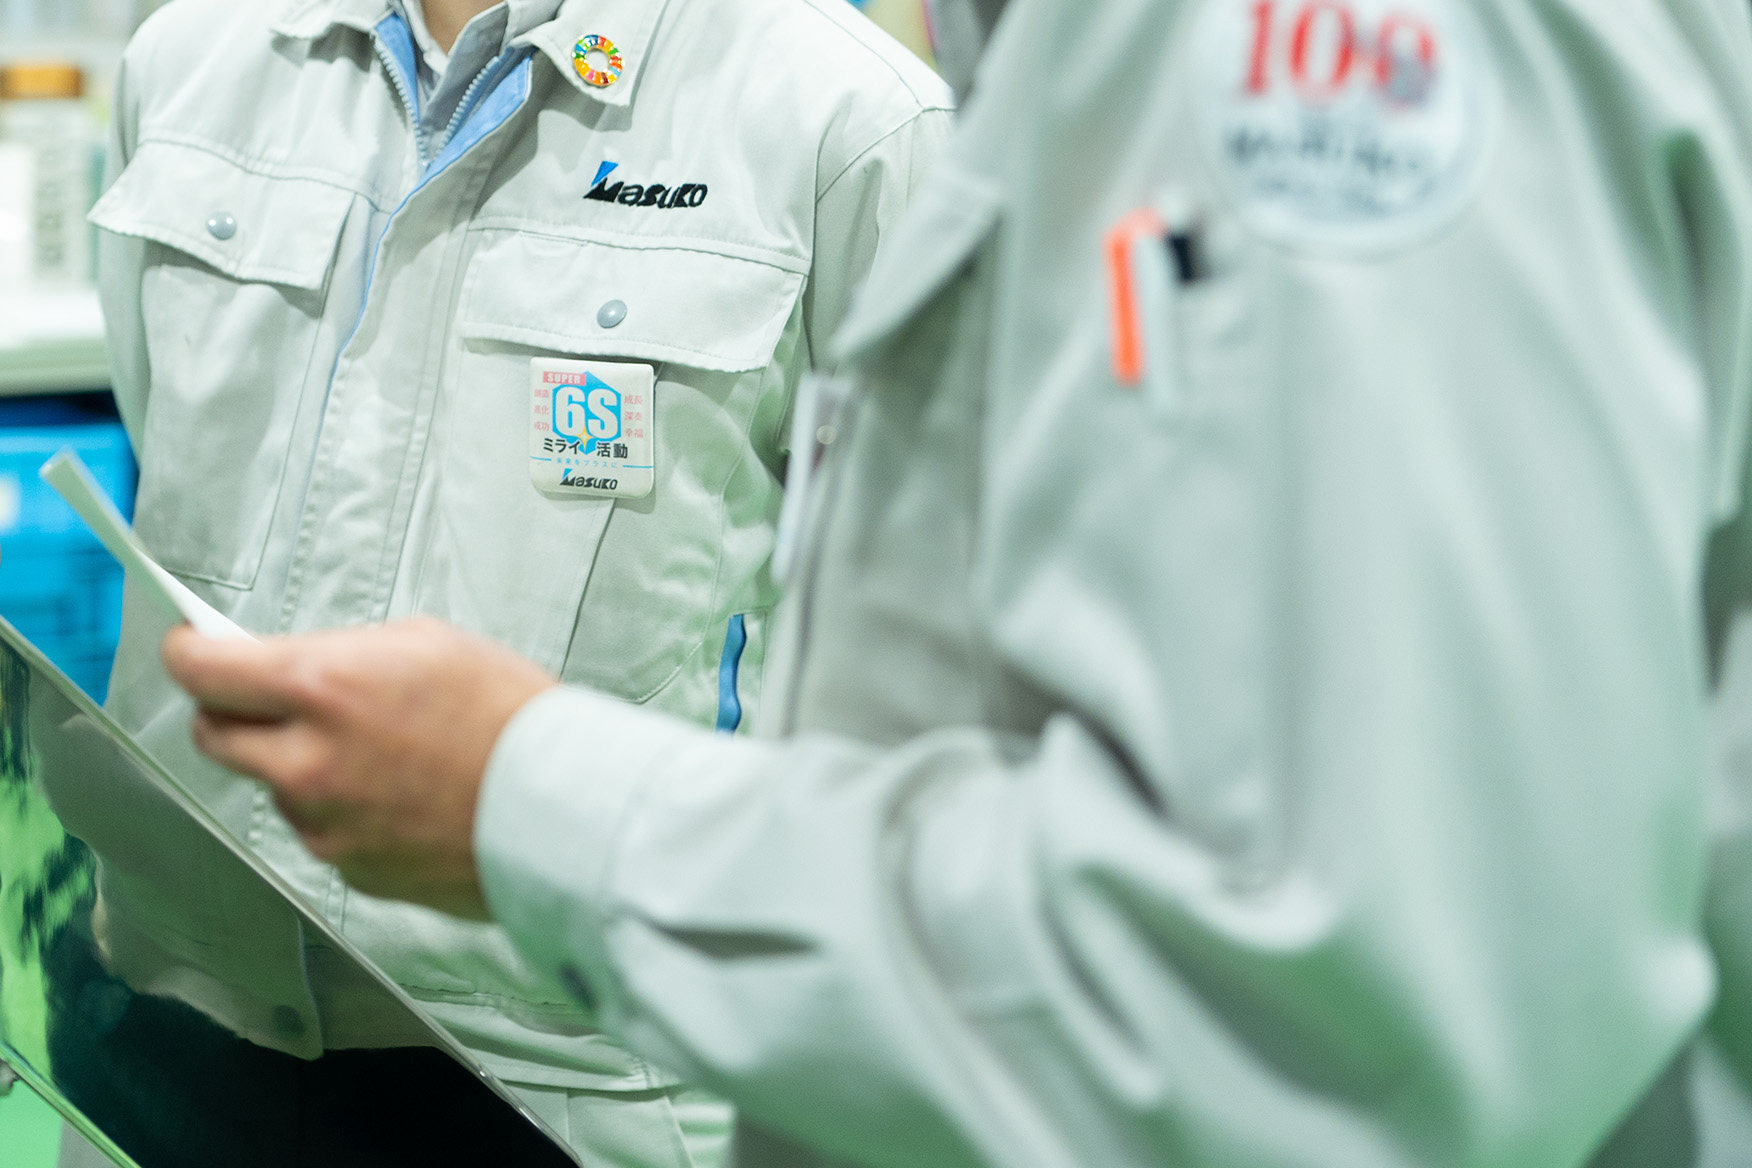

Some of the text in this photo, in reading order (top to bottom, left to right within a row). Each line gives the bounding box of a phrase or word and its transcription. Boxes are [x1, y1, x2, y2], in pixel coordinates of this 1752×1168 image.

[547, 372, 581, 384] SUPER
[555, 386, 618, 440] 6S
[625, 428, 644, 439] 幸福
